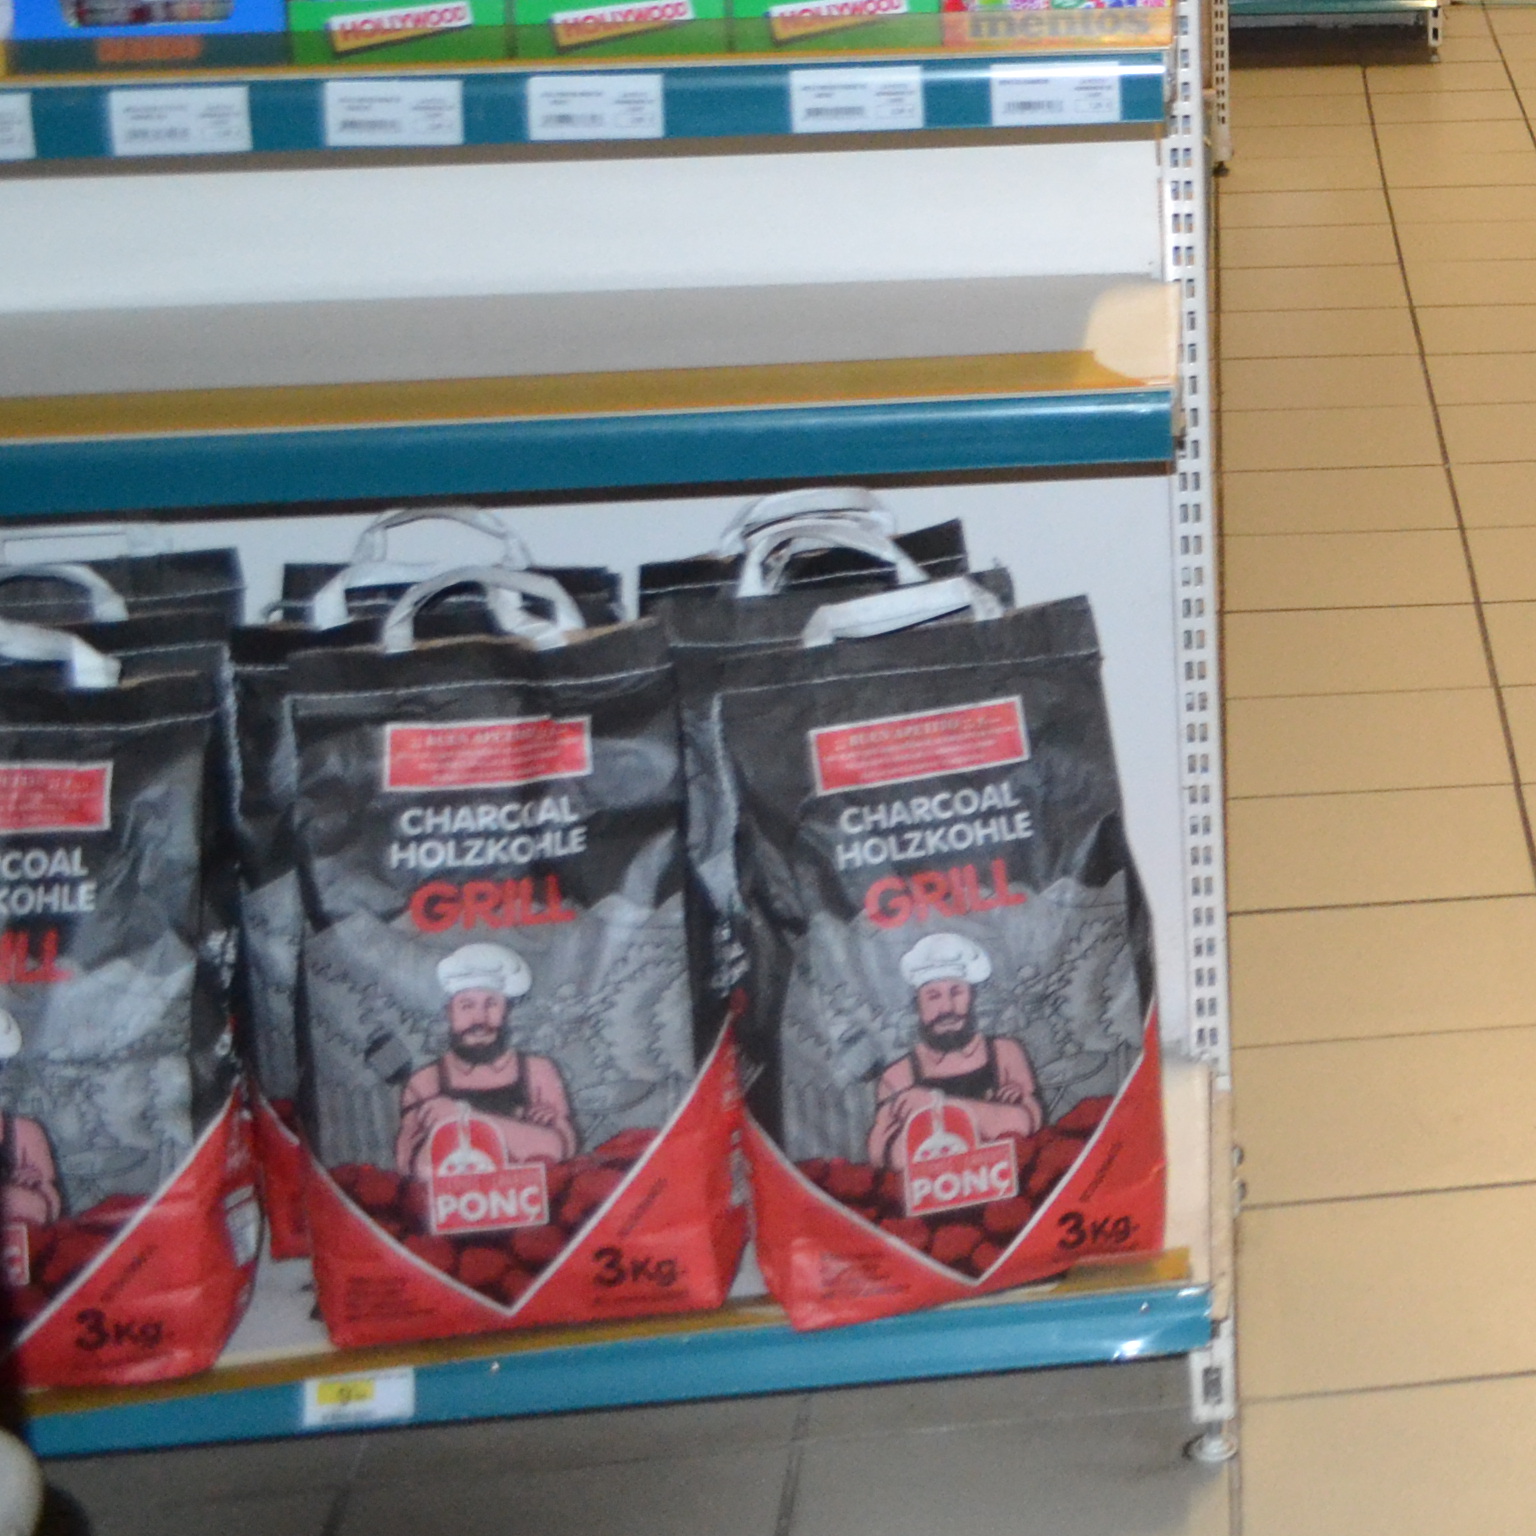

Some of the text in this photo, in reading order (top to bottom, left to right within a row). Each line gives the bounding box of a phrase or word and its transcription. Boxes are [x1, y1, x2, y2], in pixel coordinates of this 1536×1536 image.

[336, 4, 468, 41] HOLLYWOOD
[837, 779, 1022, 837] CHARCOAL
[389, 825, 589, 870] HOLZKOHLE
[834, 810, 1035, 872] HOLZKOHLE
[408, 874, 578, 934] GRILL
[862, 858, 1028, 931] GRILL
[436, 1184, 542, 1222] PONÇ
[910, 1161, 1012, 1206] PONÇ
